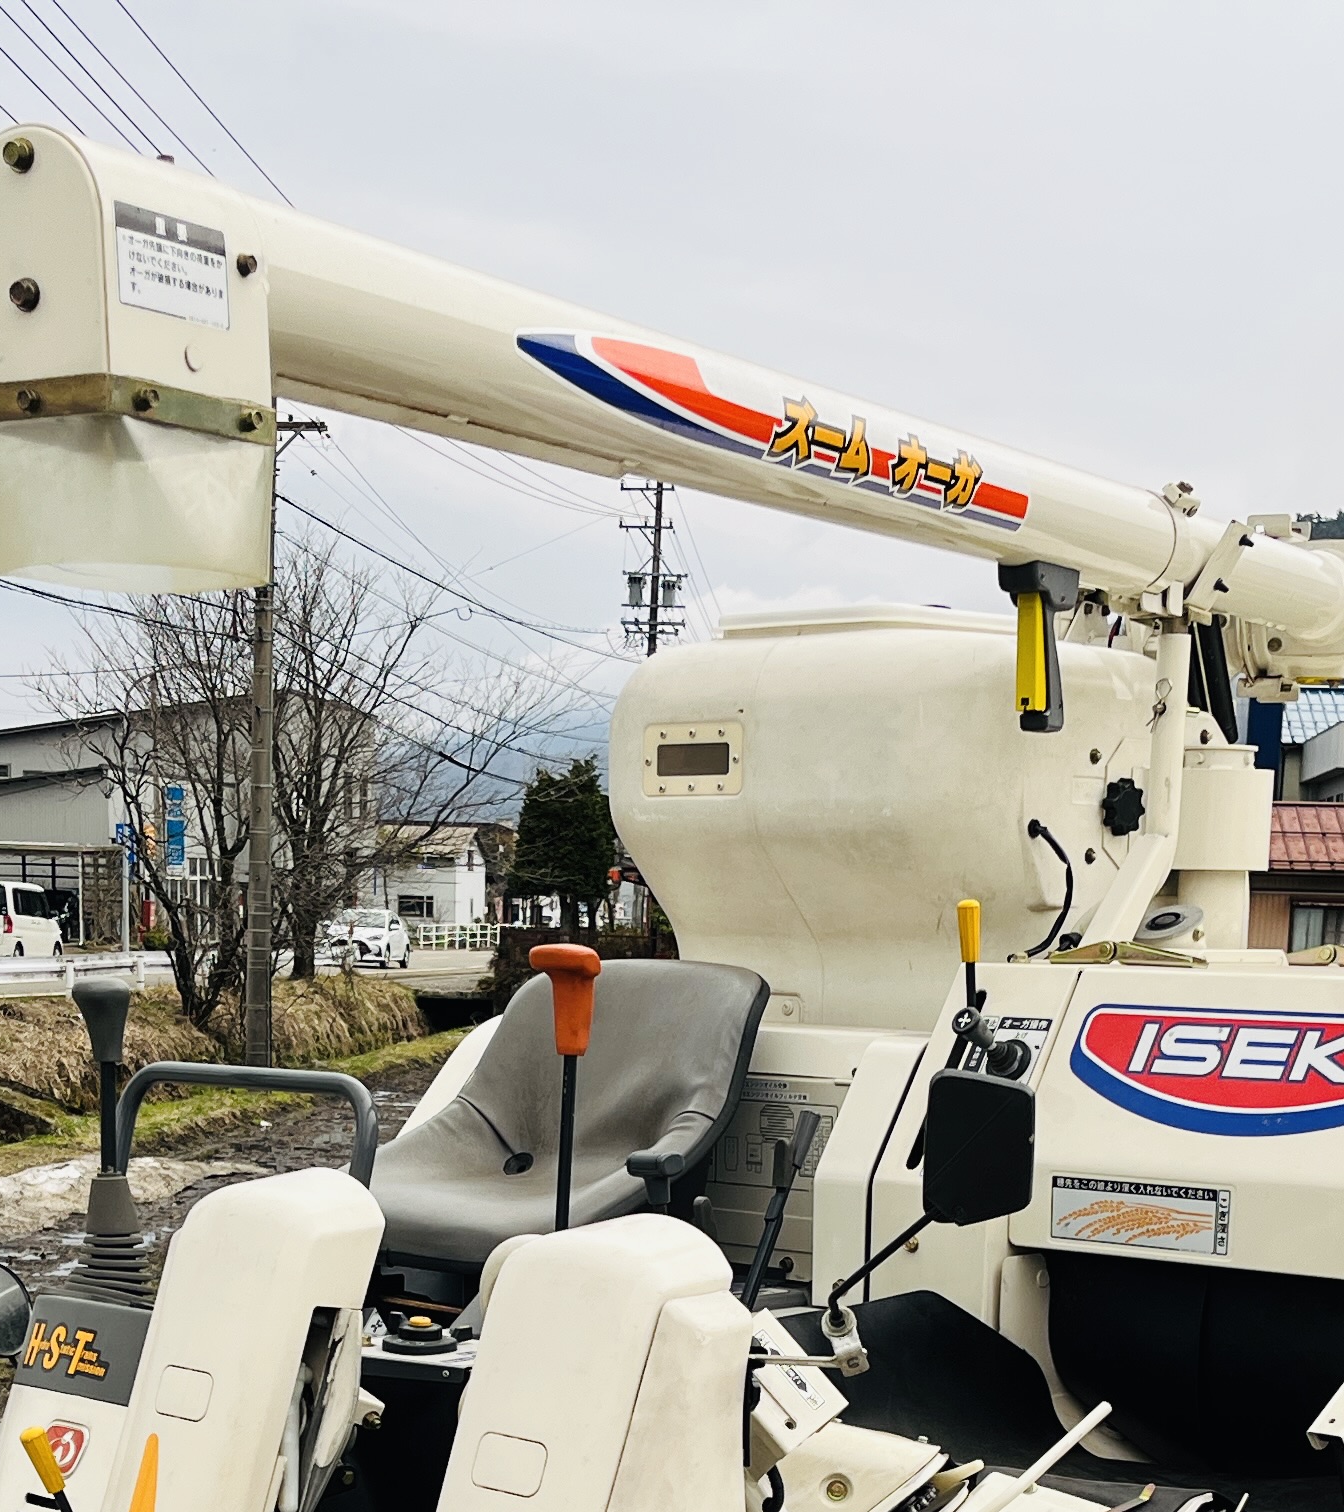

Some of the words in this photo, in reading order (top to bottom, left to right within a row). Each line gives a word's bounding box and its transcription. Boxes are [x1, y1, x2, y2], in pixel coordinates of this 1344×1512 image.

[768, 396, 871, 478] ズーム
[892, 434, 983, 509] オーガ
